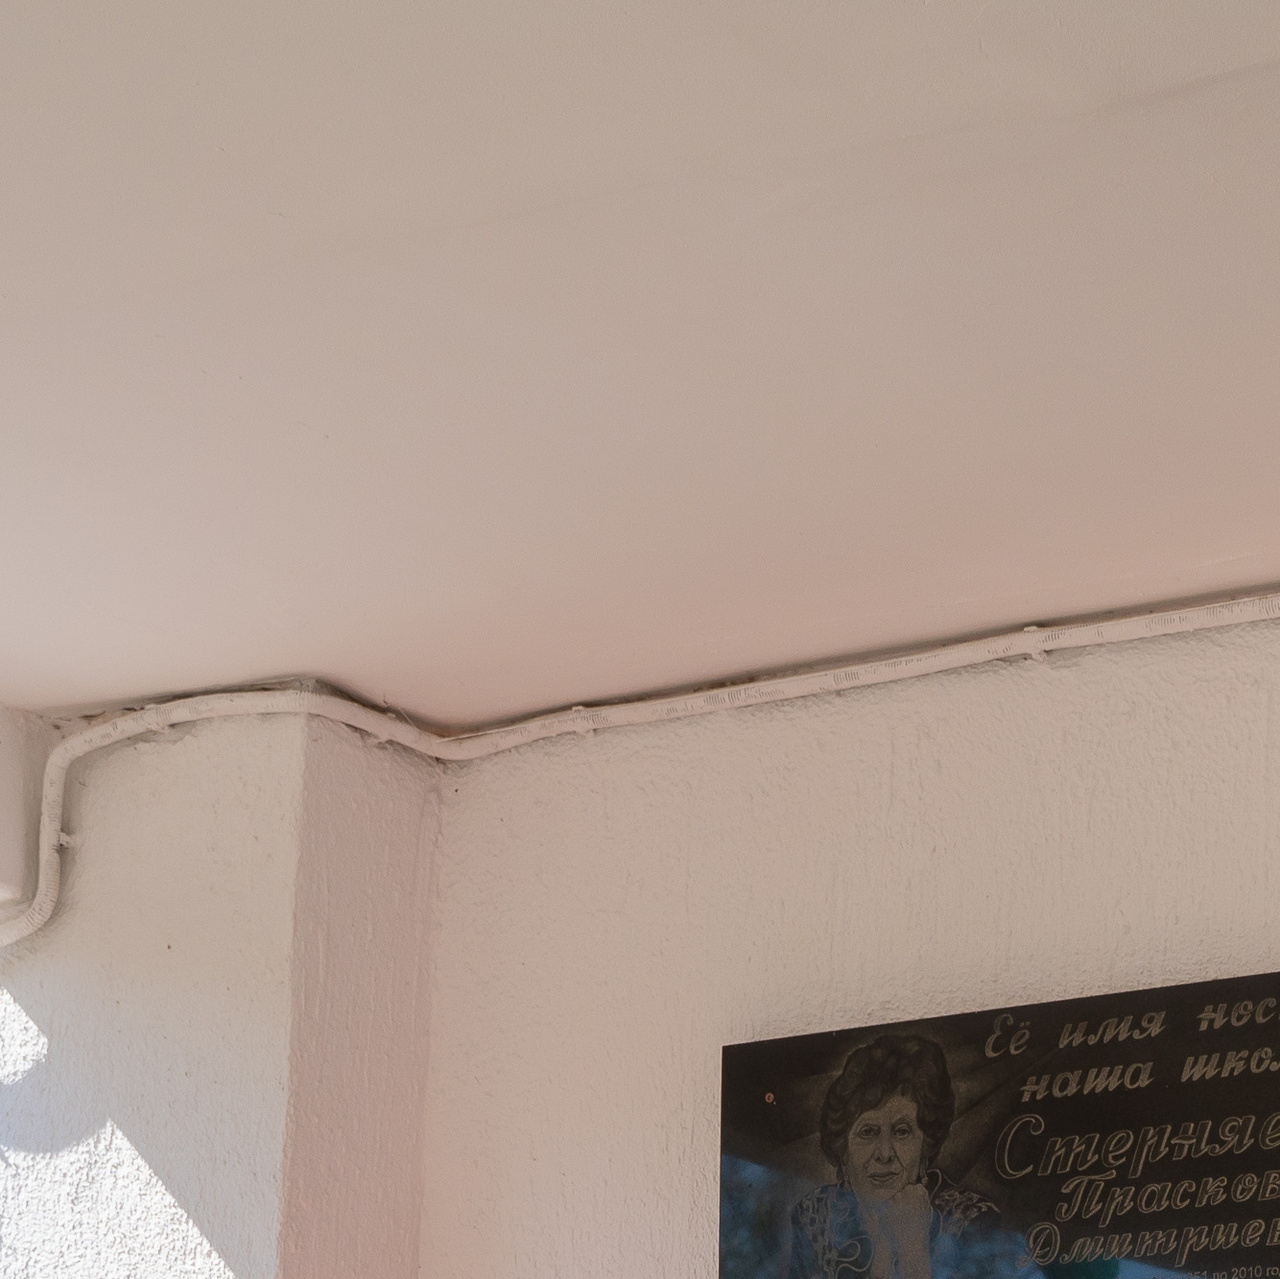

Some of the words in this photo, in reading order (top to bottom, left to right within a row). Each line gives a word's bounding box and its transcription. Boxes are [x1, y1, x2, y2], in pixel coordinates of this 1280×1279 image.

[984, 1013, 1031, 1058] Её
[1058, 1010, 1166, 1049] имя
[1020, 1061, 1155, 1102] наша
[1231, 1265, 1263, 1279] 2010
